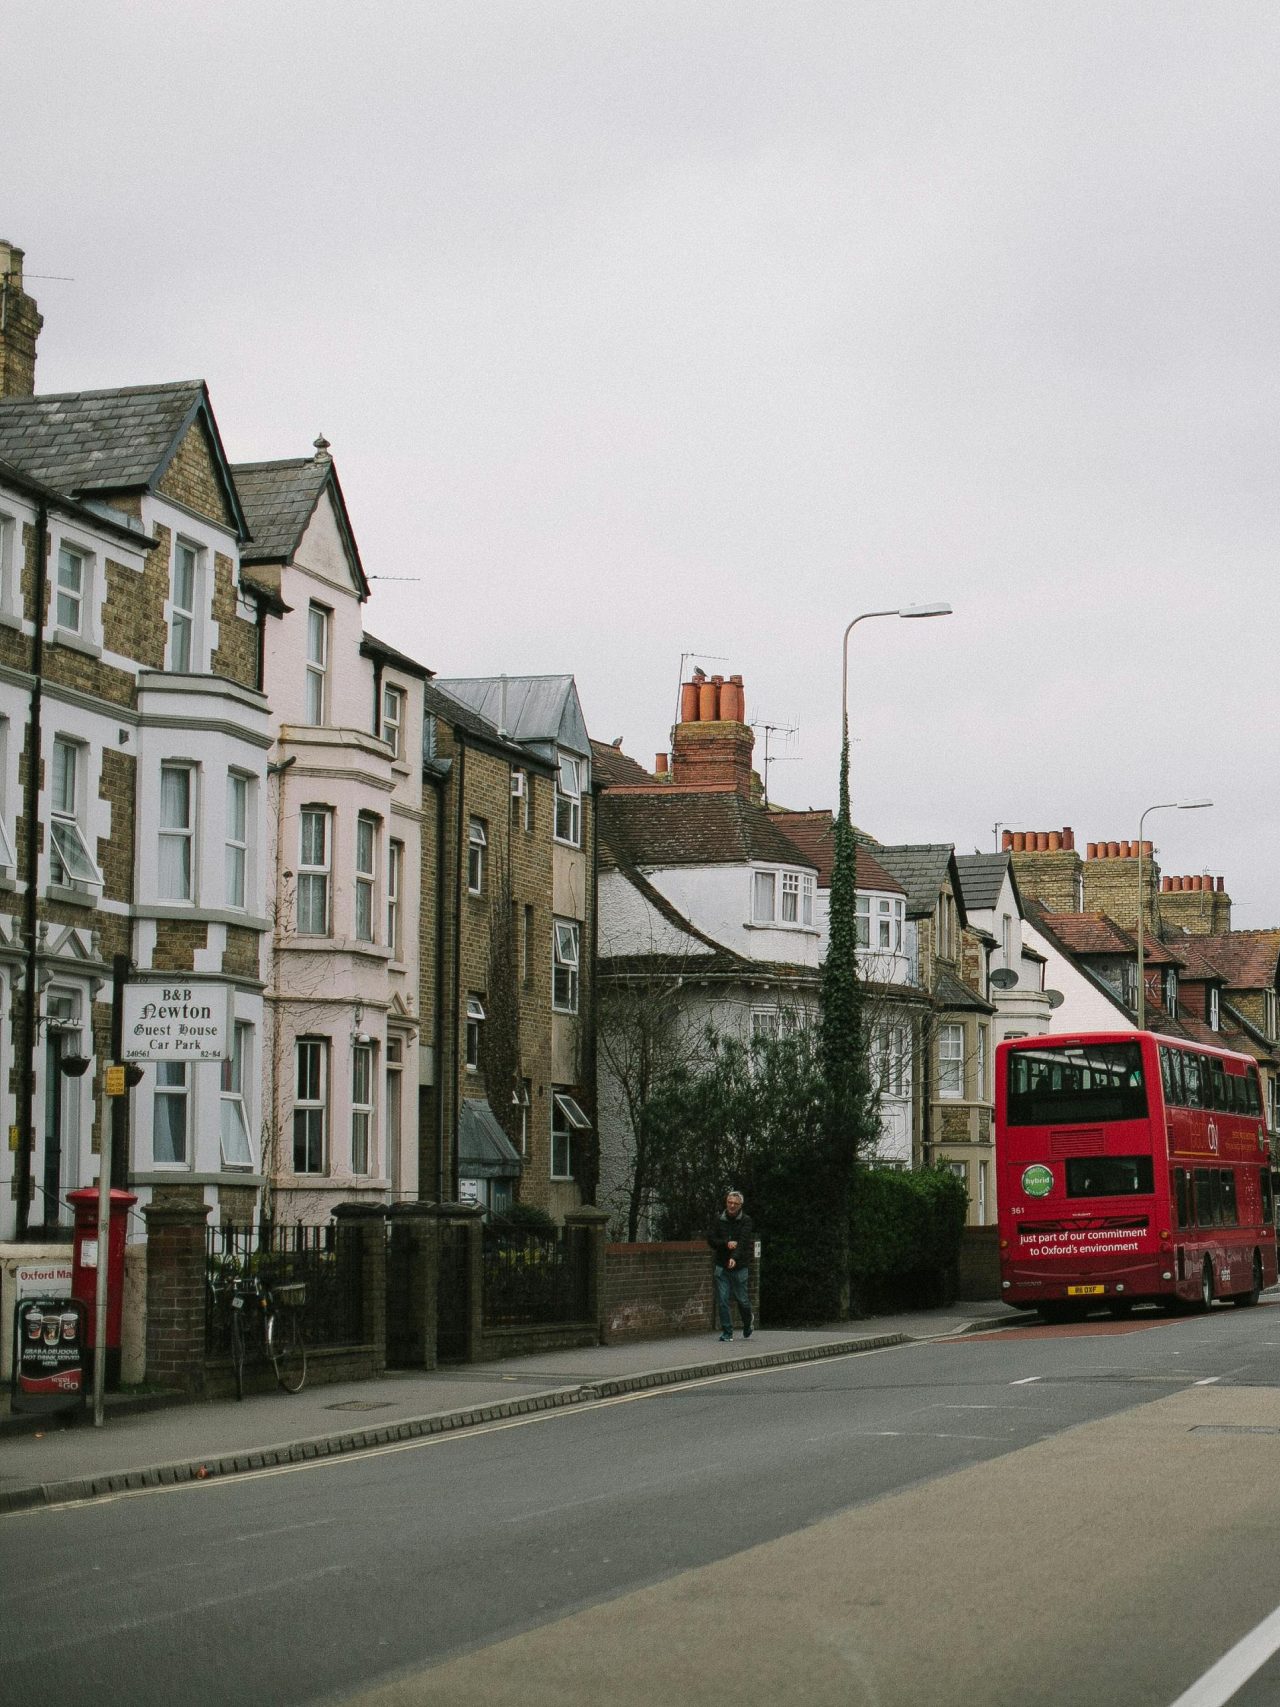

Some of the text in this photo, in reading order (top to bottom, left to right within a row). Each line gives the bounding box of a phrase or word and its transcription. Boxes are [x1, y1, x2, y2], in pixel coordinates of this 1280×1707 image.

[162, 988, 192, 1001] B&B
[139, 1002, 211, 1020] Newton
[133, 1023, 218, 1037] Guest House
[149, 1039, 201, 1050] Car Park
[126, 1050, 221, 1058] 240561 82-84
[1026, 1177, 1050, 1186] hybrid
[1011, 1207, 1025, 1215] 361
[1020, 1228, 1147, 1246] just part of our commitment
[1030, 1242, 1138, 1256] to Oxford's environment
[21, 1270, 54, 1280] Oxford
